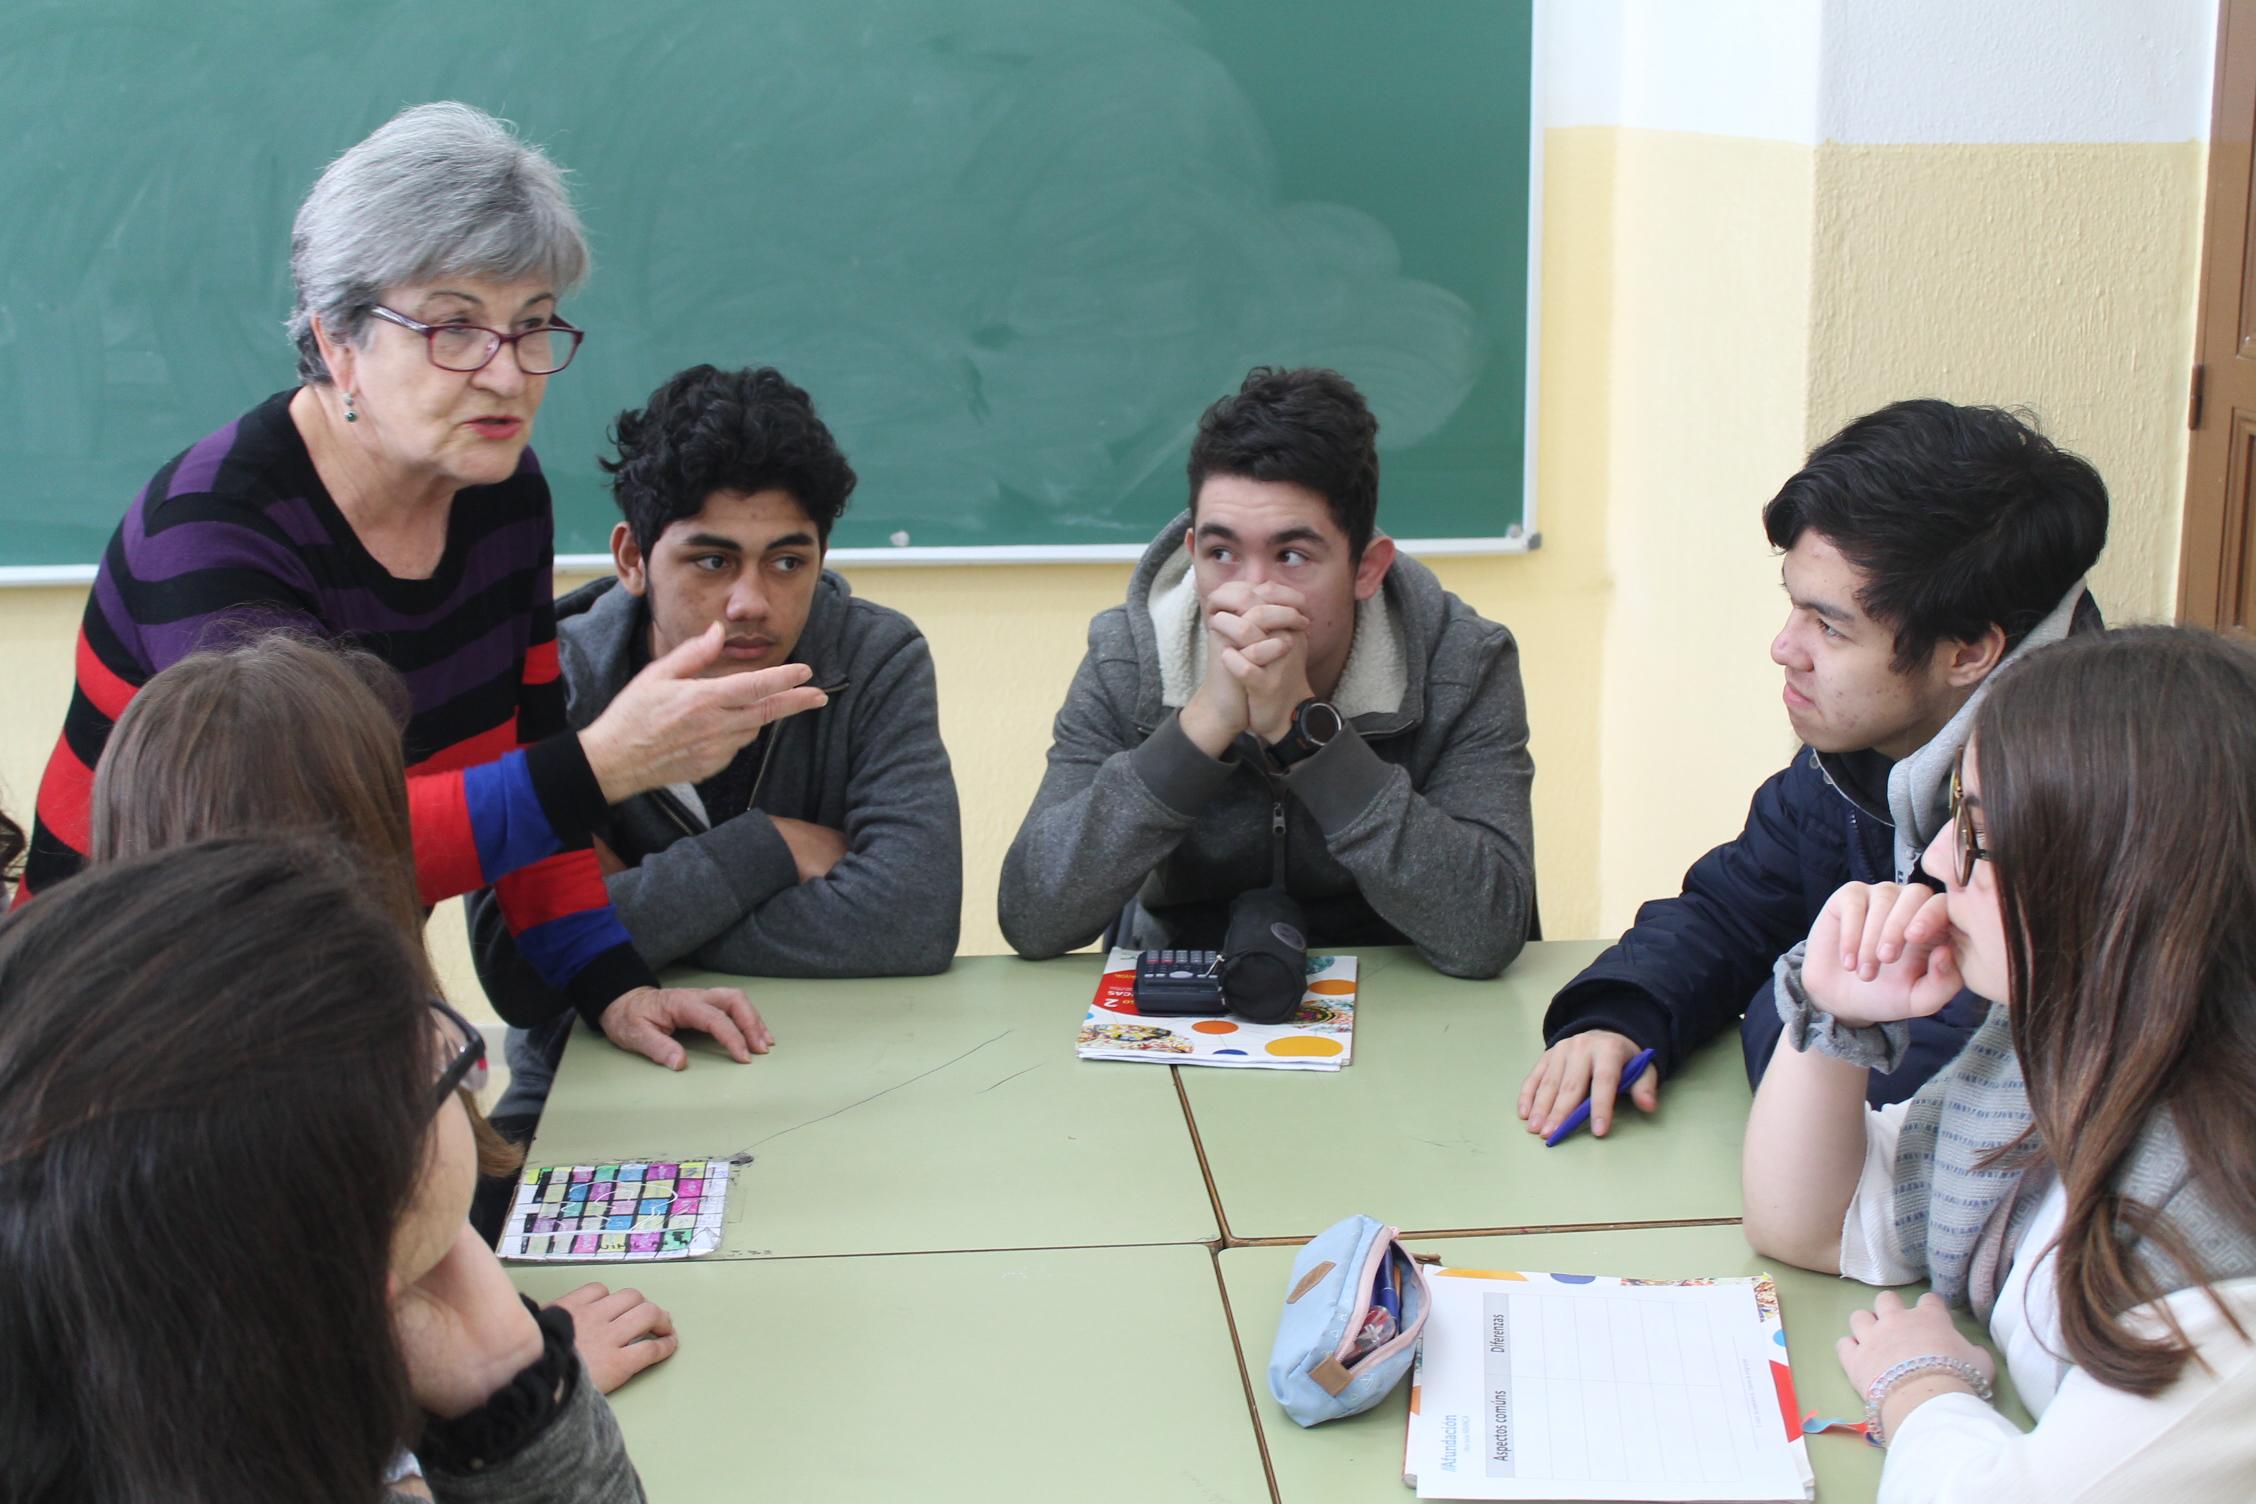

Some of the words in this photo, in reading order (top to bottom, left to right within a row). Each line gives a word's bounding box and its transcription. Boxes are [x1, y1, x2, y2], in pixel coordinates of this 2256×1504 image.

[1104, 998, 1119, 1007] 2
[1490, 1314, 1505, 1353] Diferenzas
[1491, 1390, 1507, 1422] comúns
[1493, 1425, 1512, 1462] Aspectos
